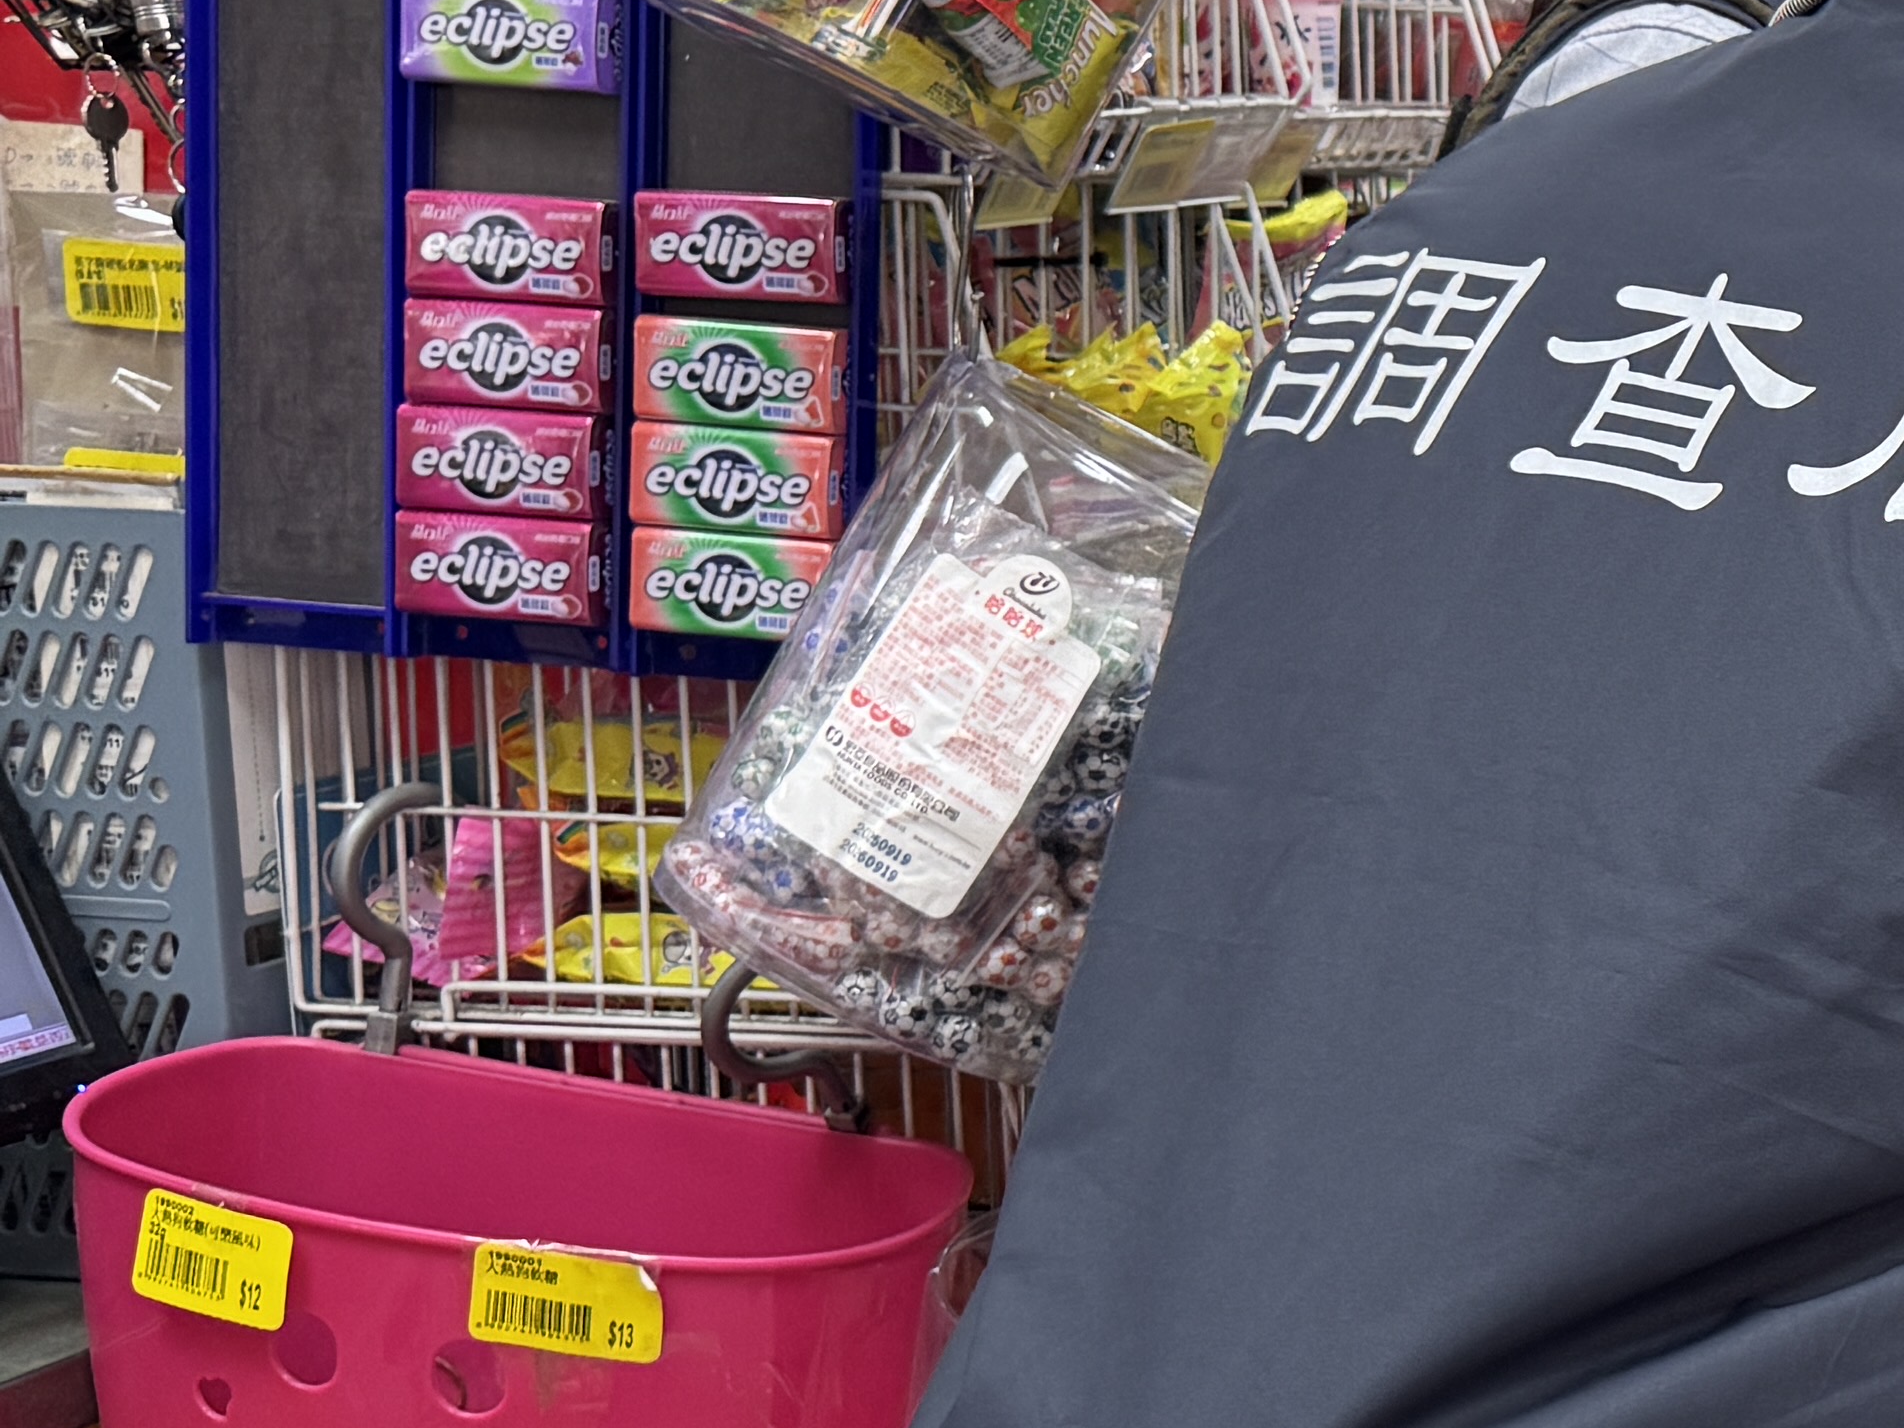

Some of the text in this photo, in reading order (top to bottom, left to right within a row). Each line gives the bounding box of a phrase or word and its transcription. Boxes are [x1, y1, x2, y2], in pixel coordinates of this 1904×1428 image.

[420, 6, 575, 59] eclipse
[420, 225, 582, 278] eclipse
[650, 225, 816, 277] eclipse
[419, 334, 580, 386] eclipse
[649, 353, 814, 405] eclipse
[411, 439, 572, 493] eclipse
[646, 460, 811, 513] eclipse
[410, 546, 570, 599] eclipse
[646, 564, 812, 617] eclipse
[239, 1280, 261, 1311] $12
[607, 1322, 635, 1350] $13
